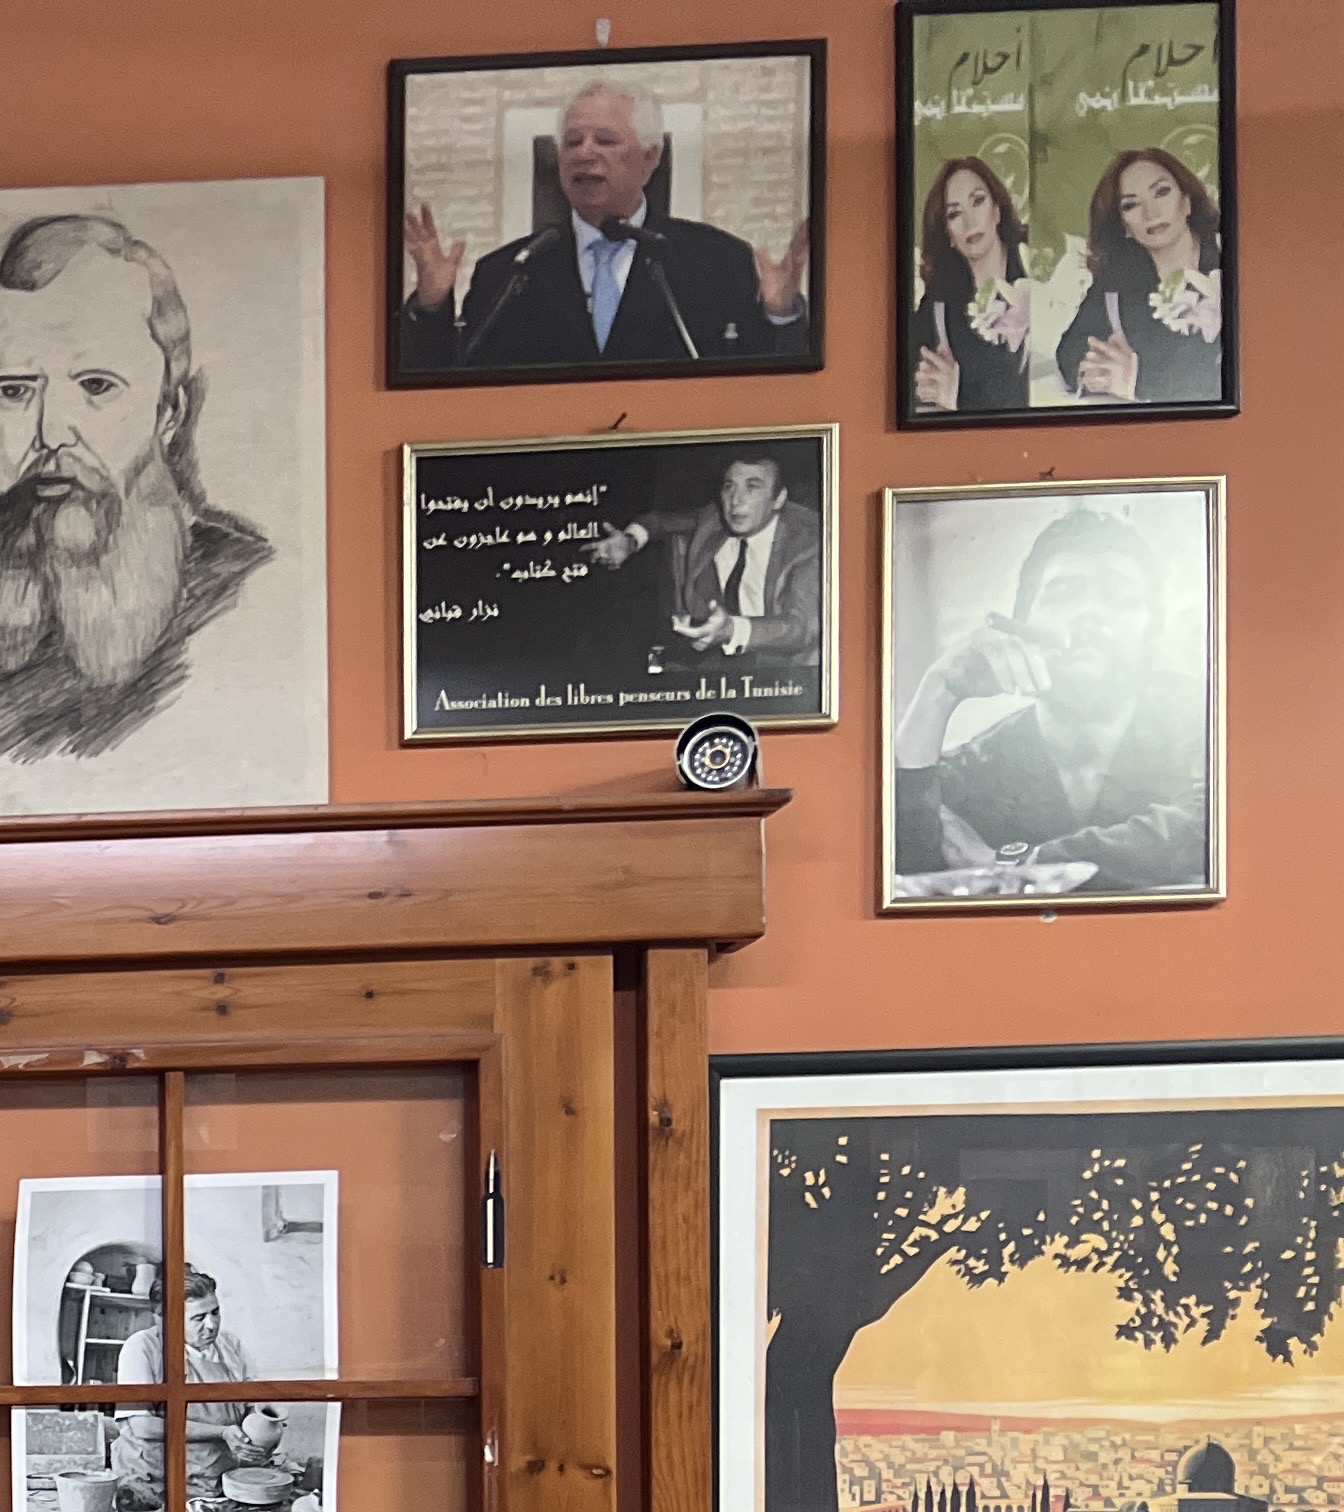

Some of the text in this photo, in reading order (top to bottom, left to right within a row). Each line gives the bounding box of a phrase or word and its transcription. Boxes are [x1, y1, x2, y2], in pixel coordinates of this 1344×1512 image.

[434, 675, 804, 711] Association des libres penseurs de la Tunisie
